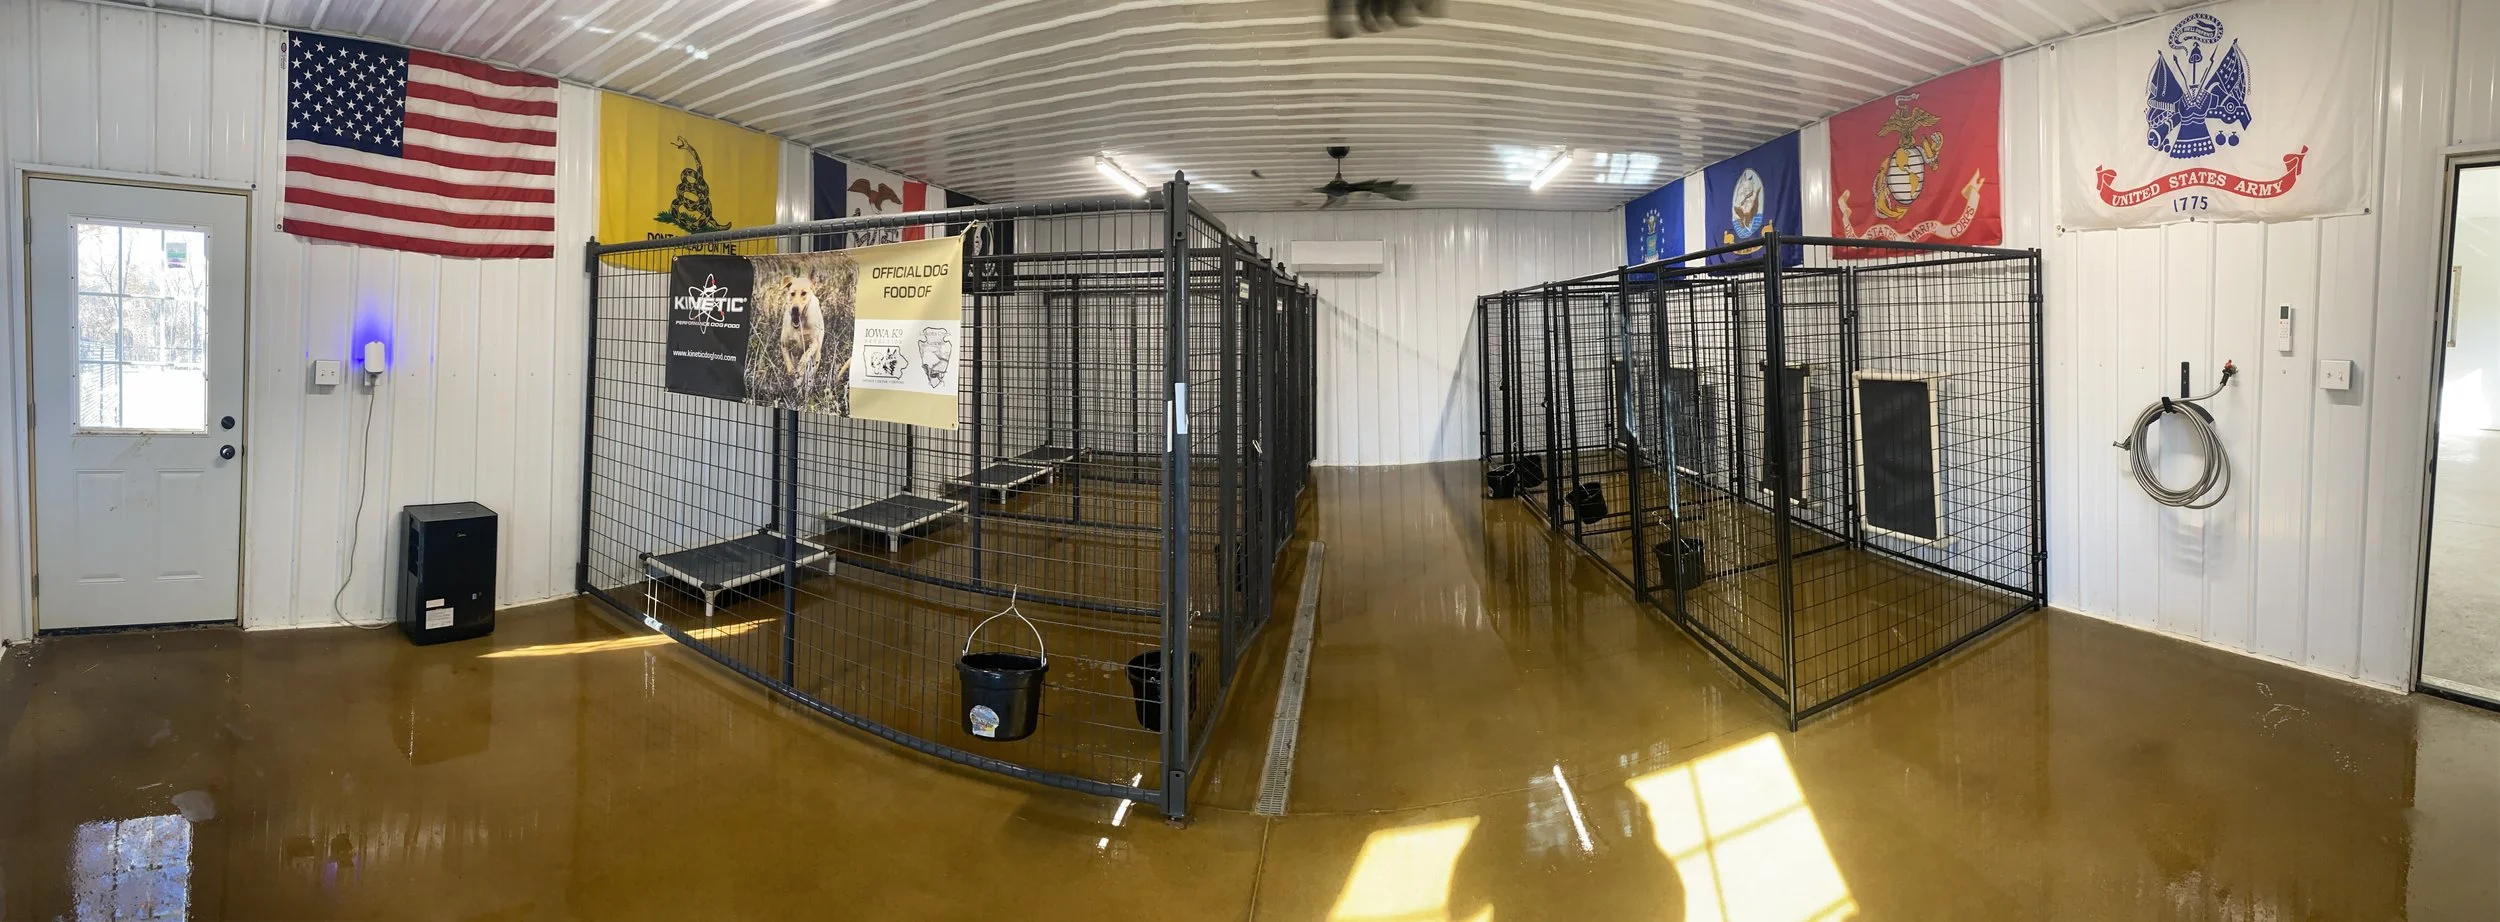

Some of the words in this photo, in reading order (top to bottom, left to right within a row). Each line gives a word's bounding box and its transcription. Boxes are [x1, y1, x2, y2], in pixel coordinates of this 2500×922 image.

[2112, 184, 2160, 206] UNITED
[2168, 171, 2227, 189] STATES
[2234, 180, 2283, 196] ARMY
[2173, 196, 2208, 212] 1775
[1950, 206, 1975, 238] CORPS
[722, 243, 736, 255] ME
[872, 266, 922, 279] OFFICIAL
[923, 264, 949, 277] DOG
[883, 286, 917, 298] FOOD
[917, 285, 932, 298] OF
[674, 296, 744, 312] KINETIC
[865, 328, 889, 338] IOWA
[672, 349, 737, 362] www.kineticdogfood.com
